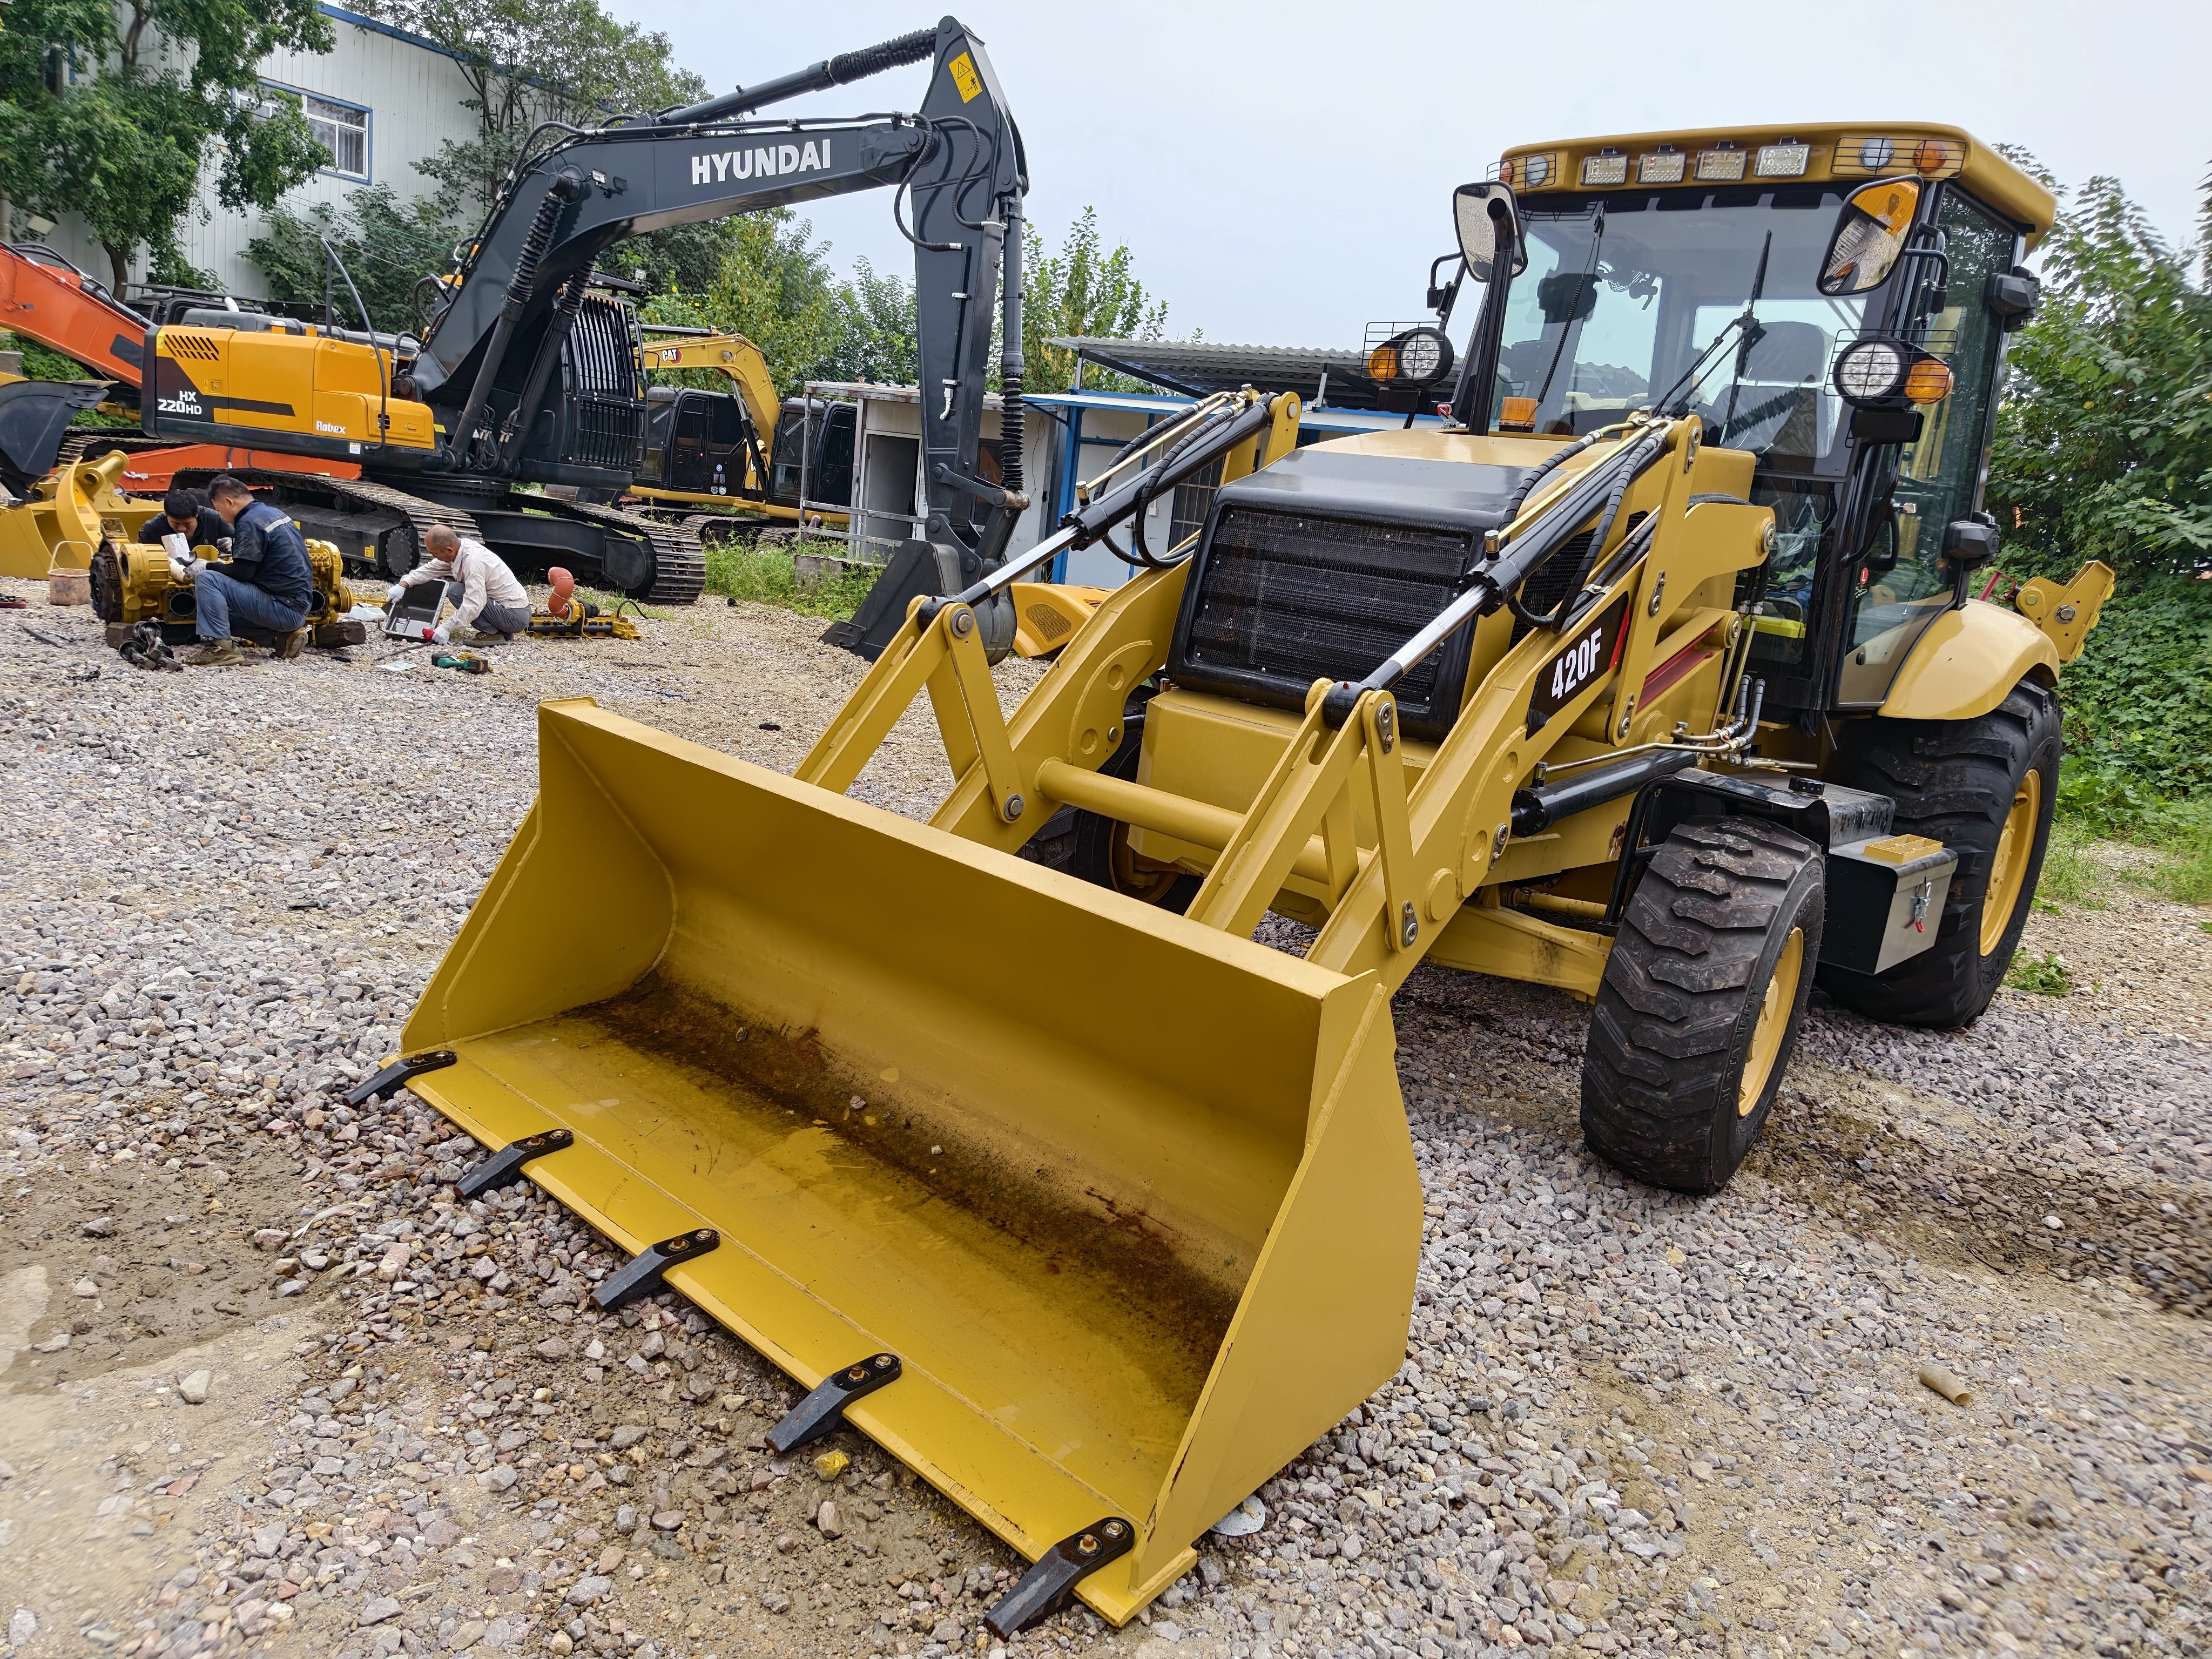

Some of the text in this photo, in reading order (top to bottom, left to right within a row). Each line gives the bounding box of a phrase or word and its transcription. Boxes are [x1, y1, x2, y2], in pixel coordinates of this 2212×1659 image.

[692, 139, 831, 185] HYUNDAI
[662, 349, 677, 361] CAT
[179, 390, 197, 402] HX
[158, 399, 202, 415] 220HD
[1552, 627, 1602, 699] 420F
